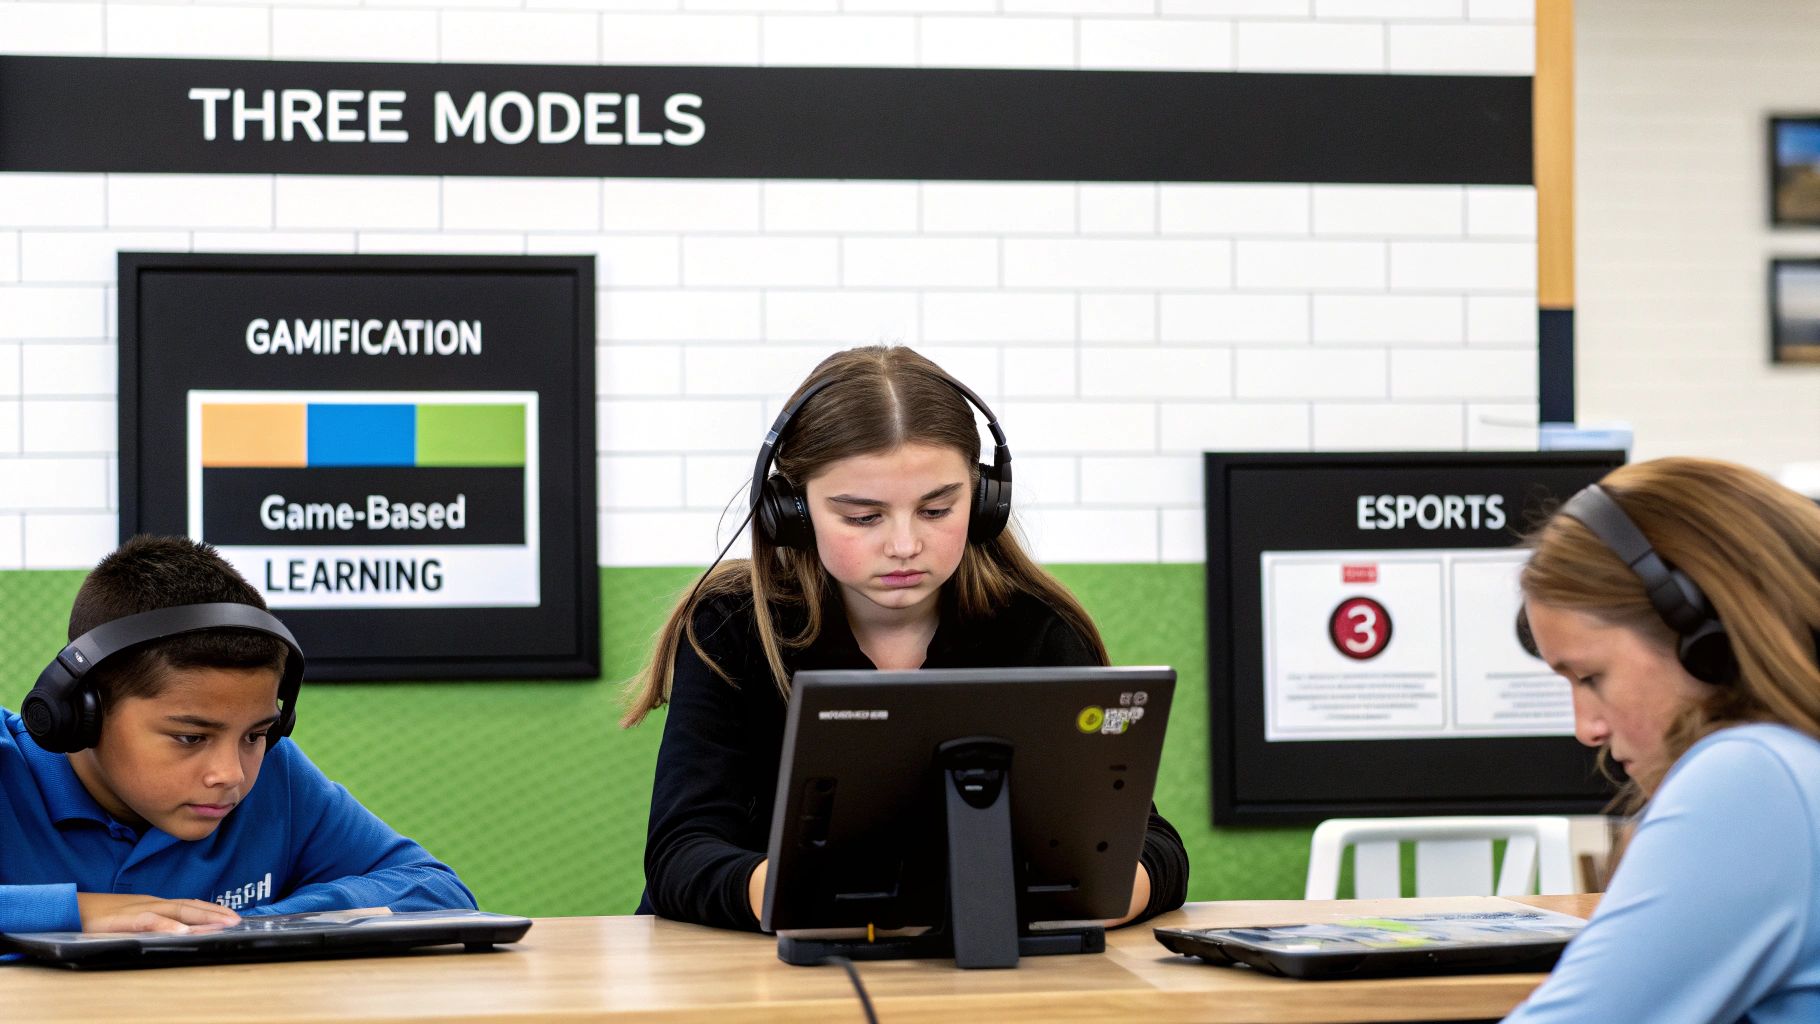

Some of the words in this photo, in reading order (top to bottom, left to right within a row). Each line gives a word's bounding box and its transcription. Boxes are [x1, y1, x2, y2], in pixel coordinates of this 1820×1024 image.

[188, 88, 409, 143] THREE
[434, 91, 706, 146] MODELS
[245, 318, 482, 356] GAMIFICATION
[259, 493, 466, 530] Game-Based
[1357, 494, 1506, 530] ESPORTS
[265, 558, 443, 593] LEARNING
[1345, 604, 1378, 653] 3
